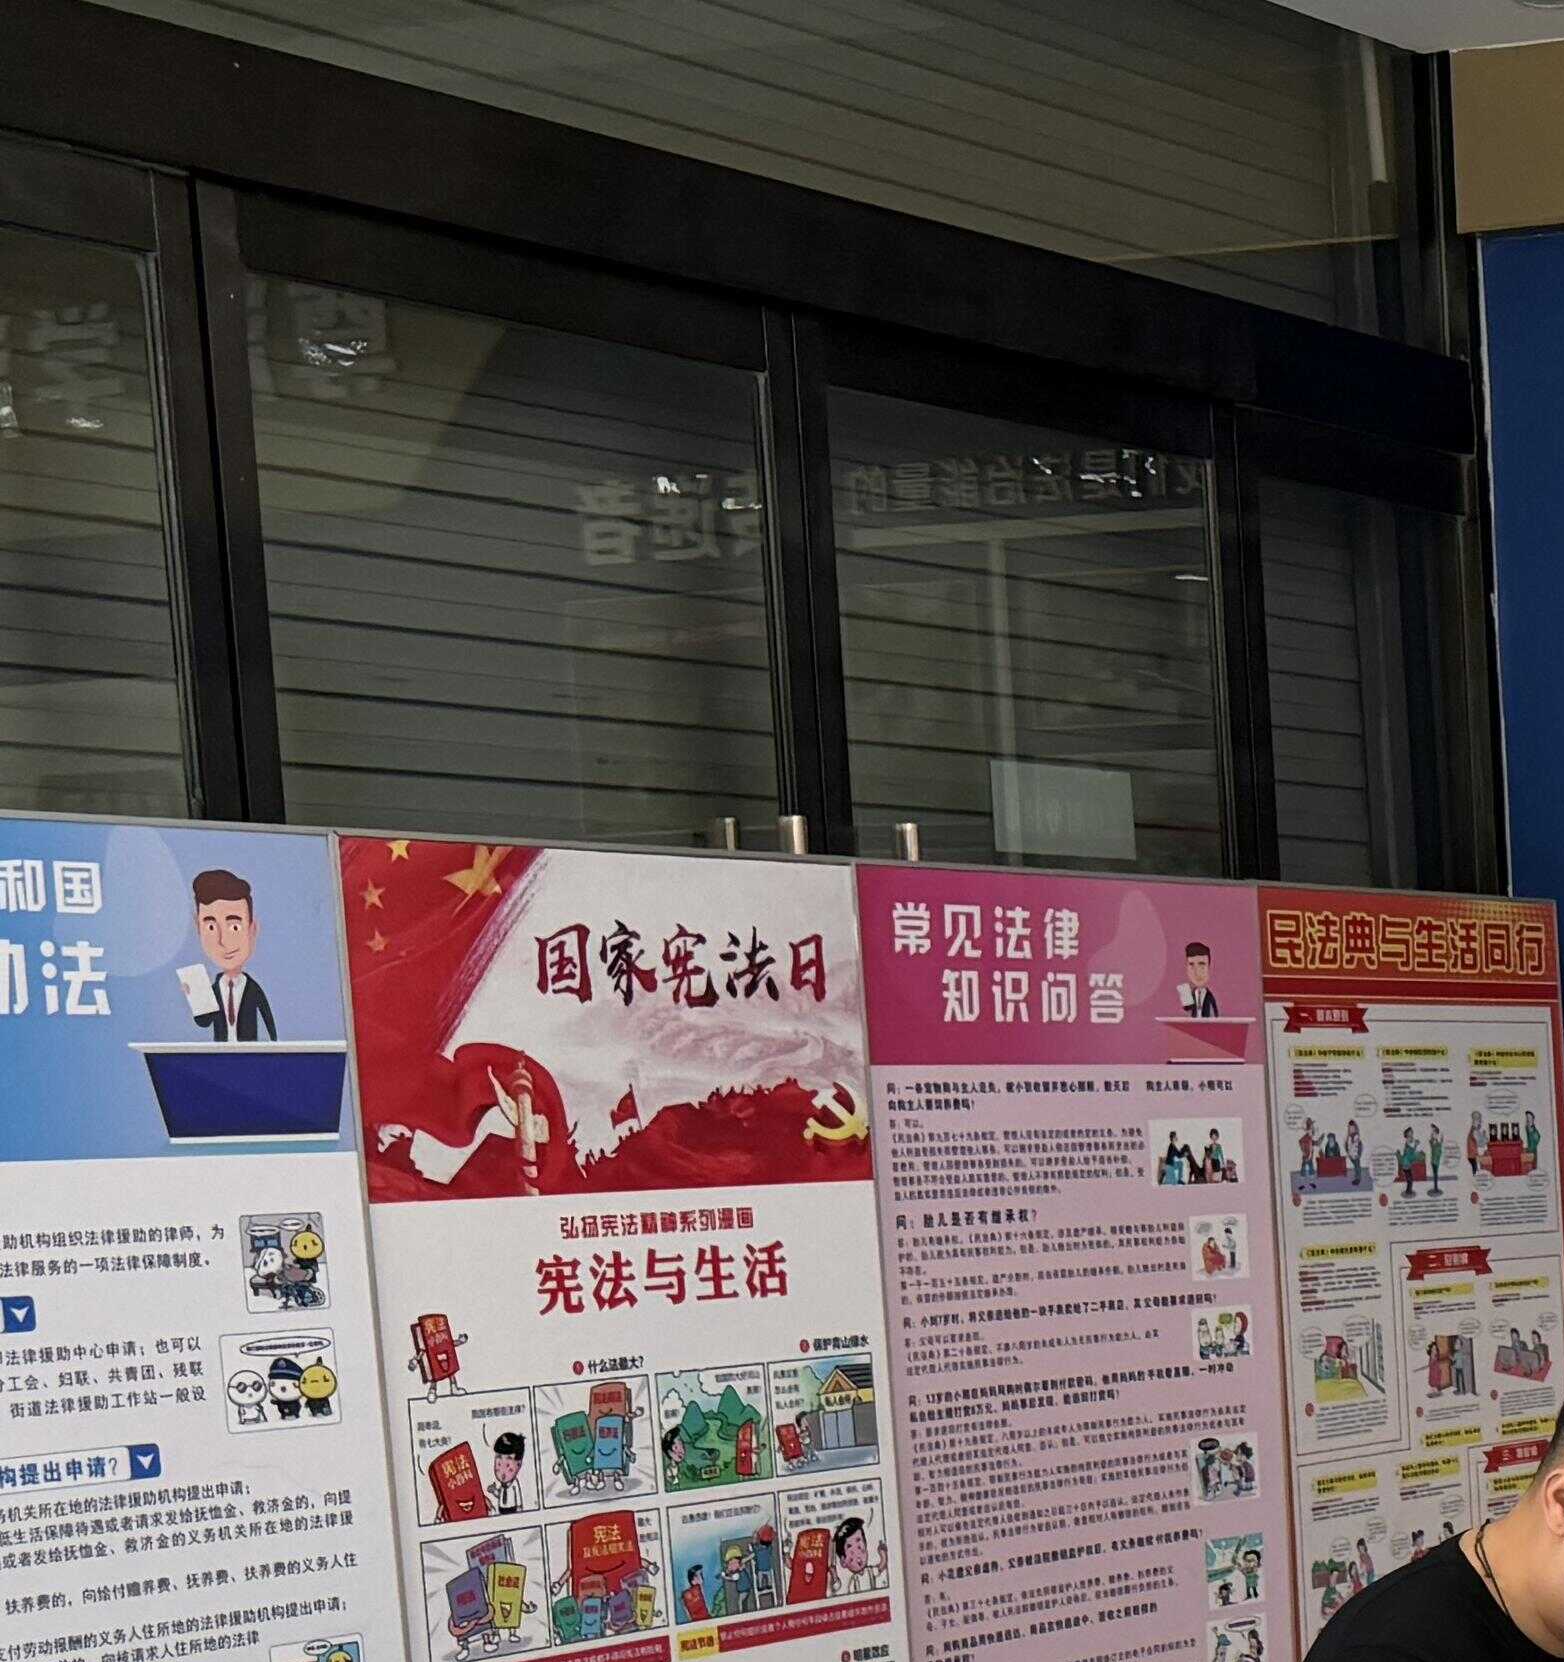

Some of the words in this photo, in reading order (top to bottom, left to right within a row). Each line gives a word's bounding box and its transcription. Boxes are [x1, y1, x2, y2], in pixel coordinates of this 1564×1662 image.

[534, 918, 827, 1008] 国家宪法日
[892, 902, 1080, 961] 常见法律
[1266, 909, 1545, 976] 民法典与生活同行
[942, 970, 1125, 1025] 知识问答
[560, 1206, 754, 1240] 弘扬宪法精神系列漫画
[534, 1240, 789, 1316] 宪法与生活
